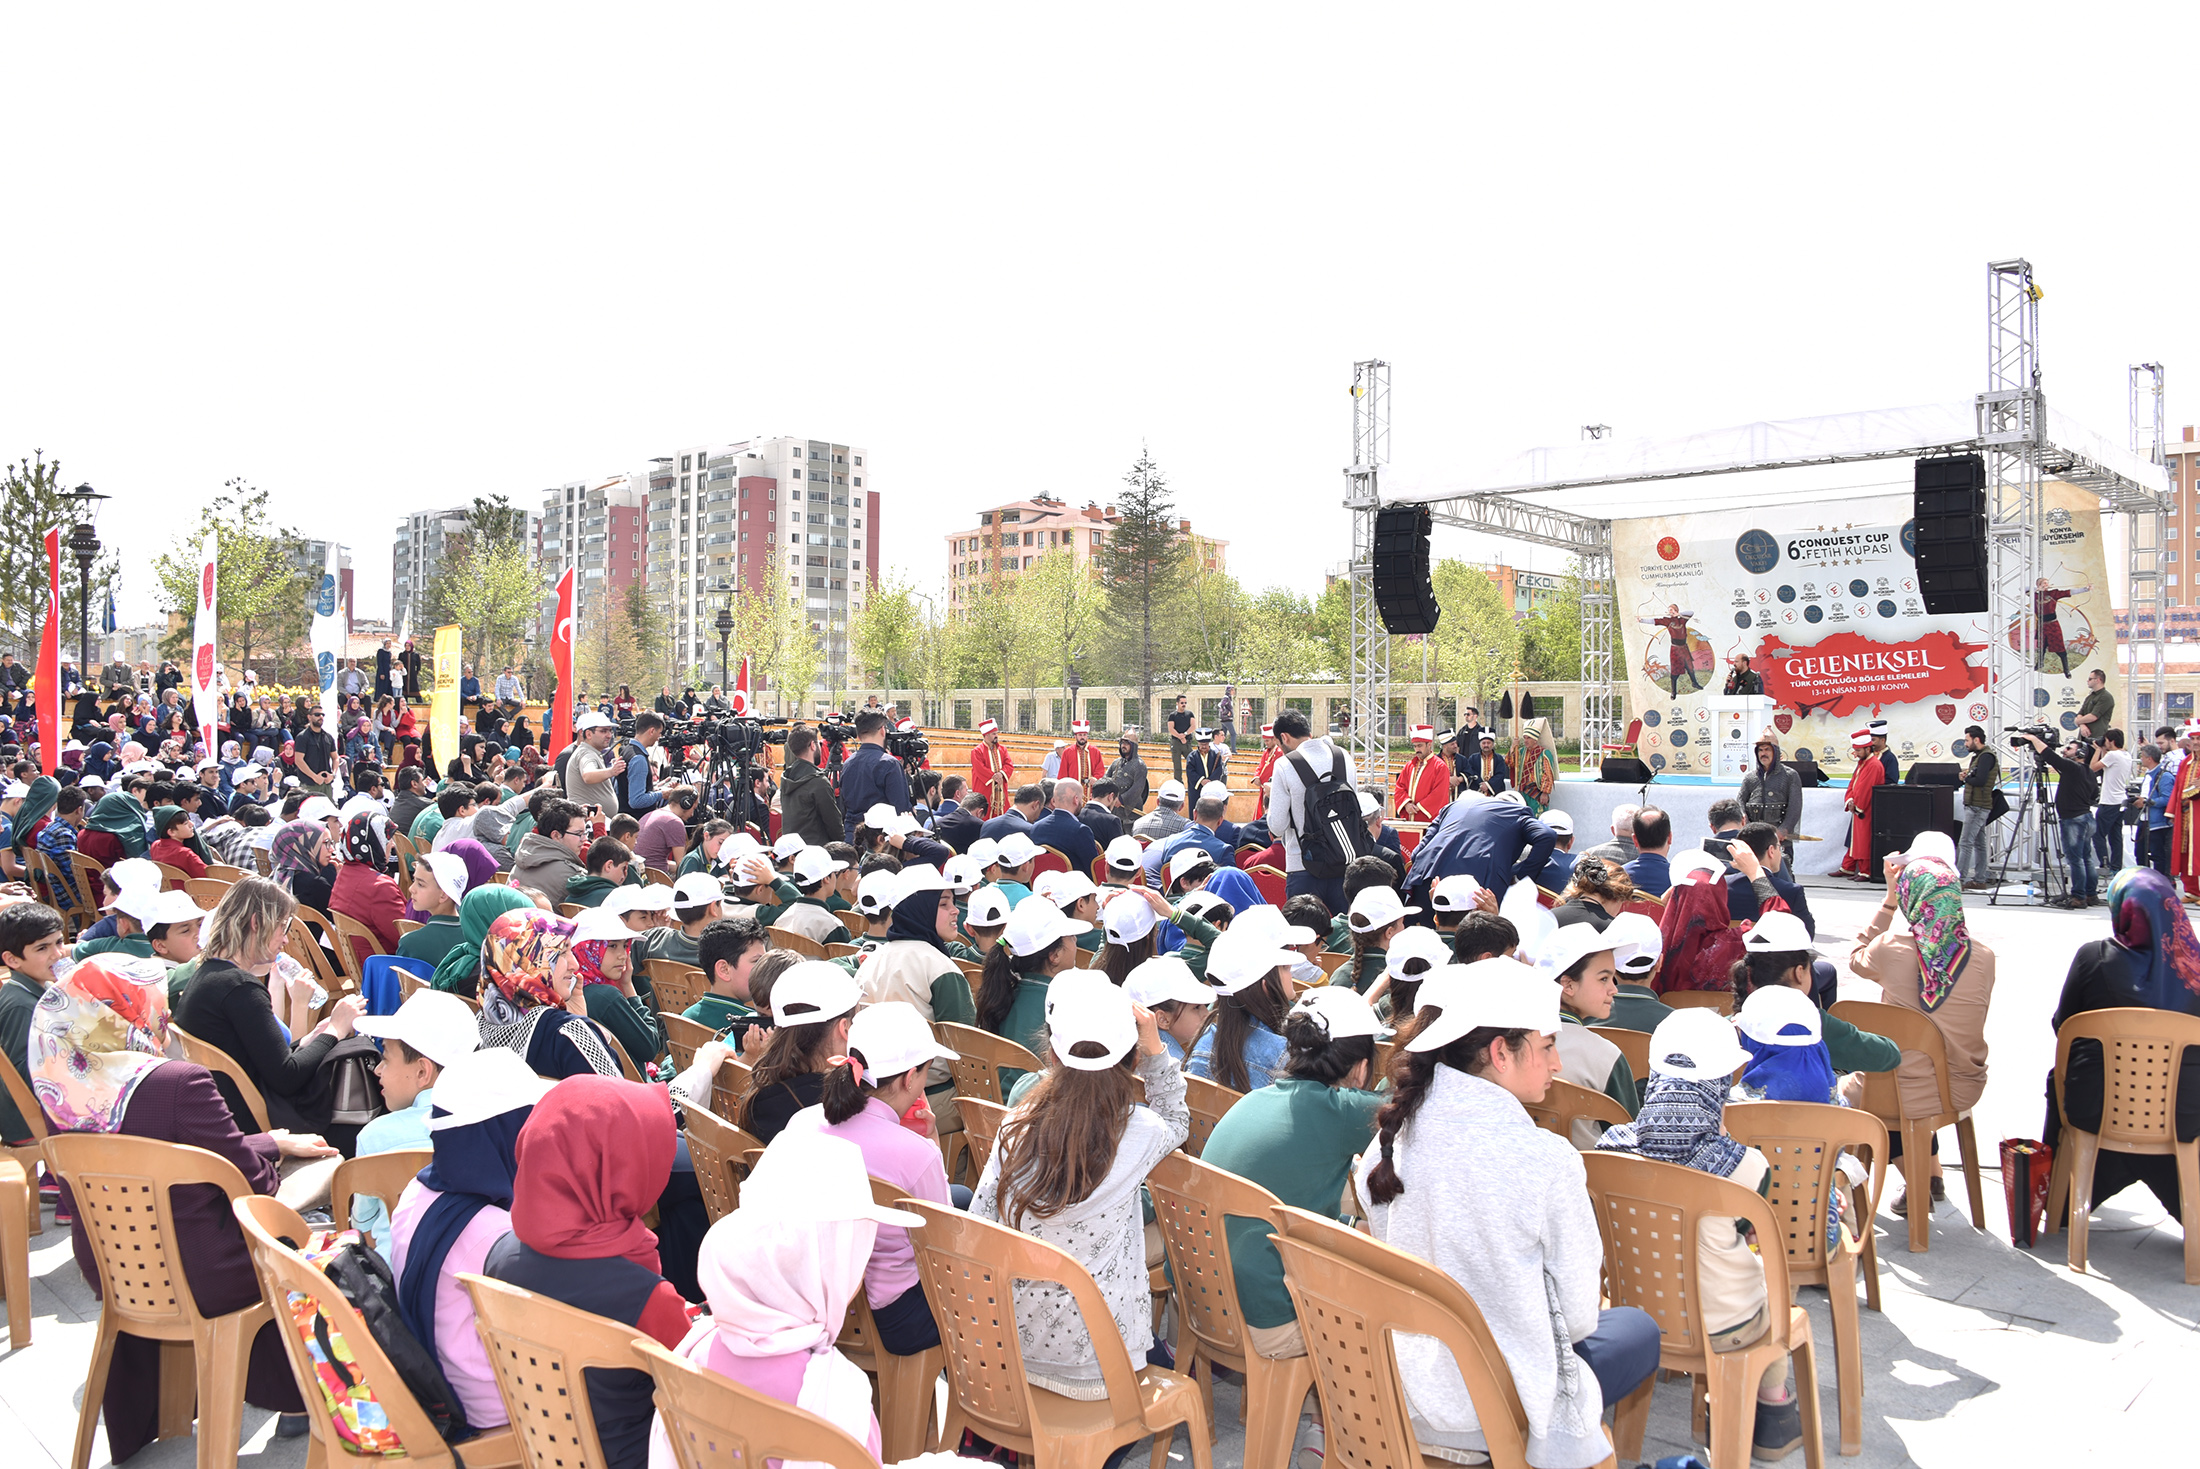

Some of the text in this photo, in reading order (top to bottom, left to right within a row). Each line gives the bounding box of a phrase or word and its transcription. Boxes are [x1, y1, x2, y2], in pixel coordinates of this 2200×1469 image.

[1798, 535, 1861, 548] CONQUEST
[1865, 533, 1889, 542] CUP
[1845, 543, 1892, 557] KUPASI
[1526, 575, 1558, 589] EKOL
[1641, 569, 1704, 581] CUMHURBAŞKANLIĞI
[1785, 650, 1946, 679] GELENEKSEL
[1790, 670, 1930, 688] TÜRK OKÇULUĞU BÖLGE ELEMELERİ
[1811, 688, 1831, 696] 13-14
[1832, 685, 1857, 695] NİSAN
[1881, 682, 1910, 691] KONYA
